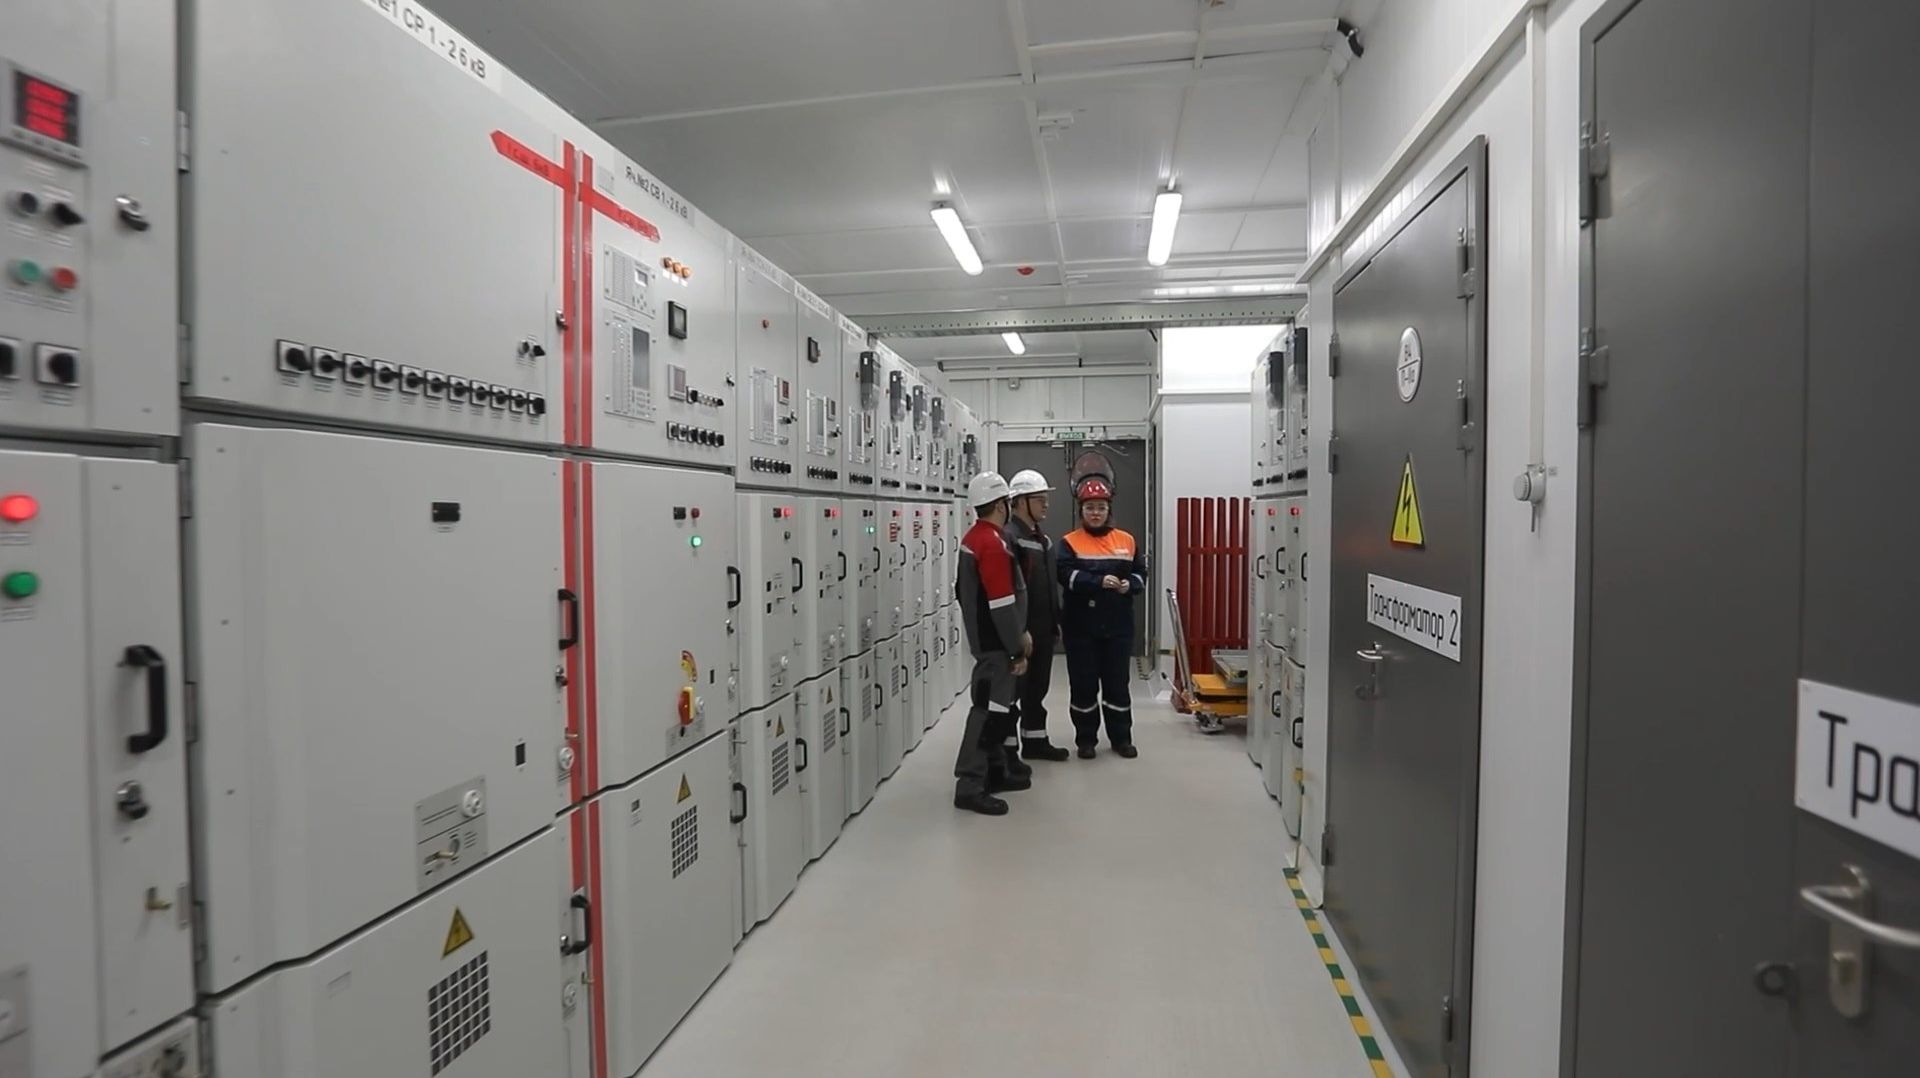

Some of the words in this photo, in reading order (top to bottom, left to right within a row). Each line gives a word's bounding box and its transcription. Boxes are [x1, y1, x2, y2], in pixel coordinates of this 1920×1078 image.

[402, 7, 425, 33] СР
[447, 39, 457, 60] 2
[1369, 583, 1445, 649] Трансформатор
[1449, 608, 1459, 647] 2
[1817, 709, 1920, 824] Тра
